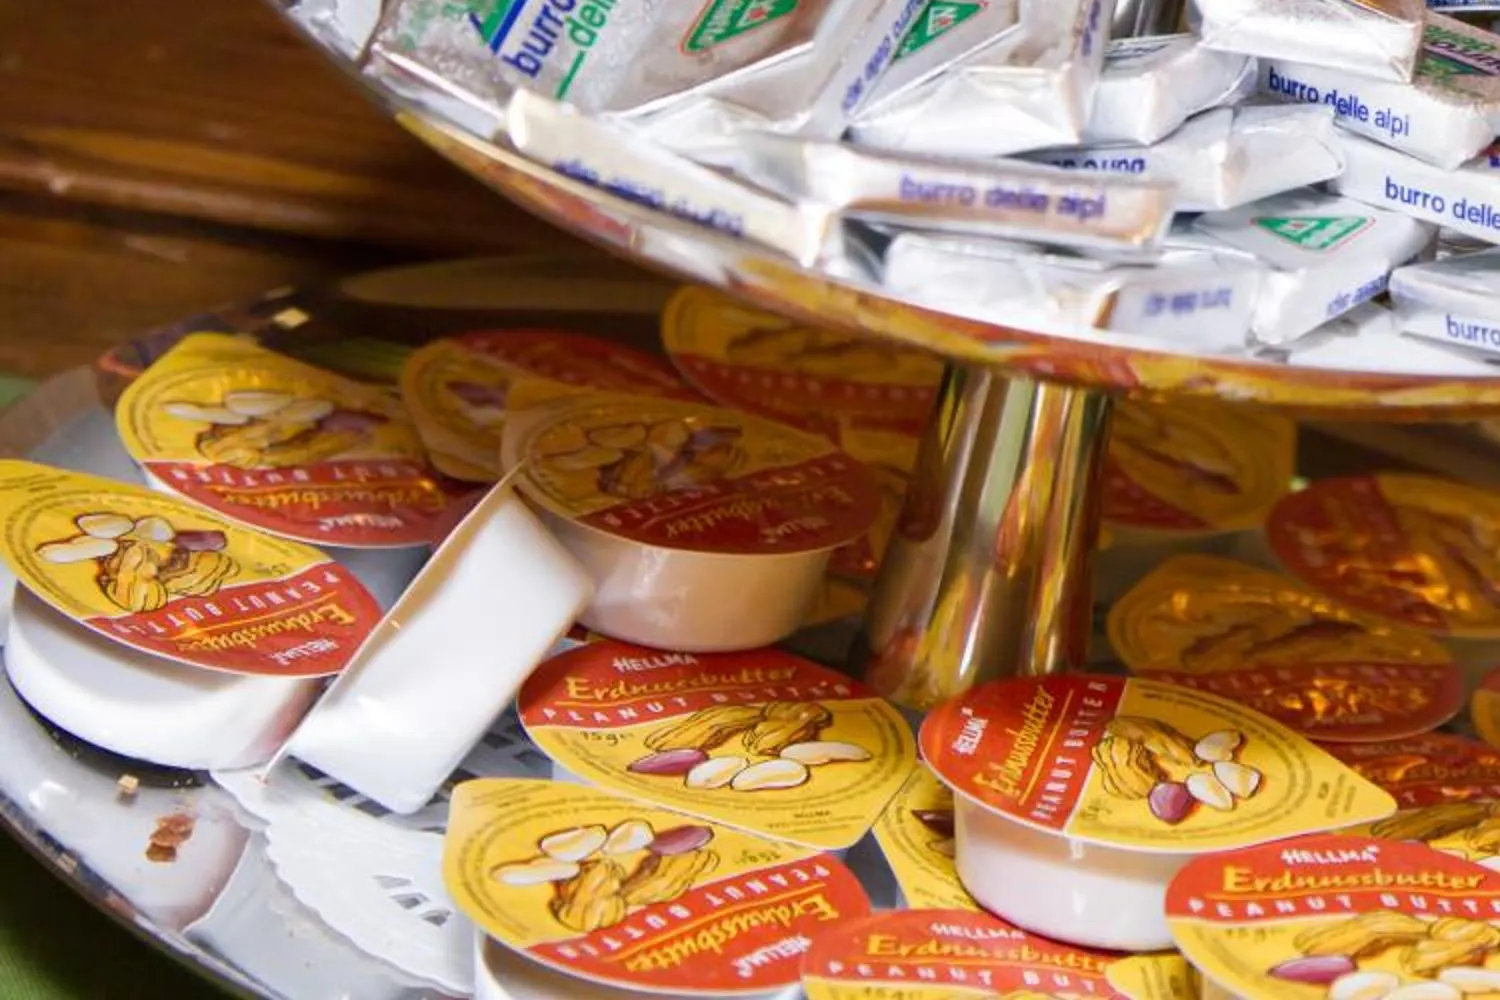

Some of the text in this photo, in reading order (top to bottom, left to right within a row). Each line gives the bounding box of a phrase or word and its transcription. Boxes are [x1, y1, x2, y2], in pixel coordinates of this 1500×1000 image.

[1269, 66, 1410, 137] burro delle alpi
[900, 174, 976, 206] burro
[1385, 176, 1445, 213] burro
[567, 665, 799, 703] Erdnussbutter
[1281, 847, 1379, 865] HELLMA
[704, 864, 831, 908] PEANUT
[1221, 864, 1486, 894] Erdnussbutter
[1188, 893, 1353, 918] PEANUT
[829, 960, 993, 987] PEANUT
